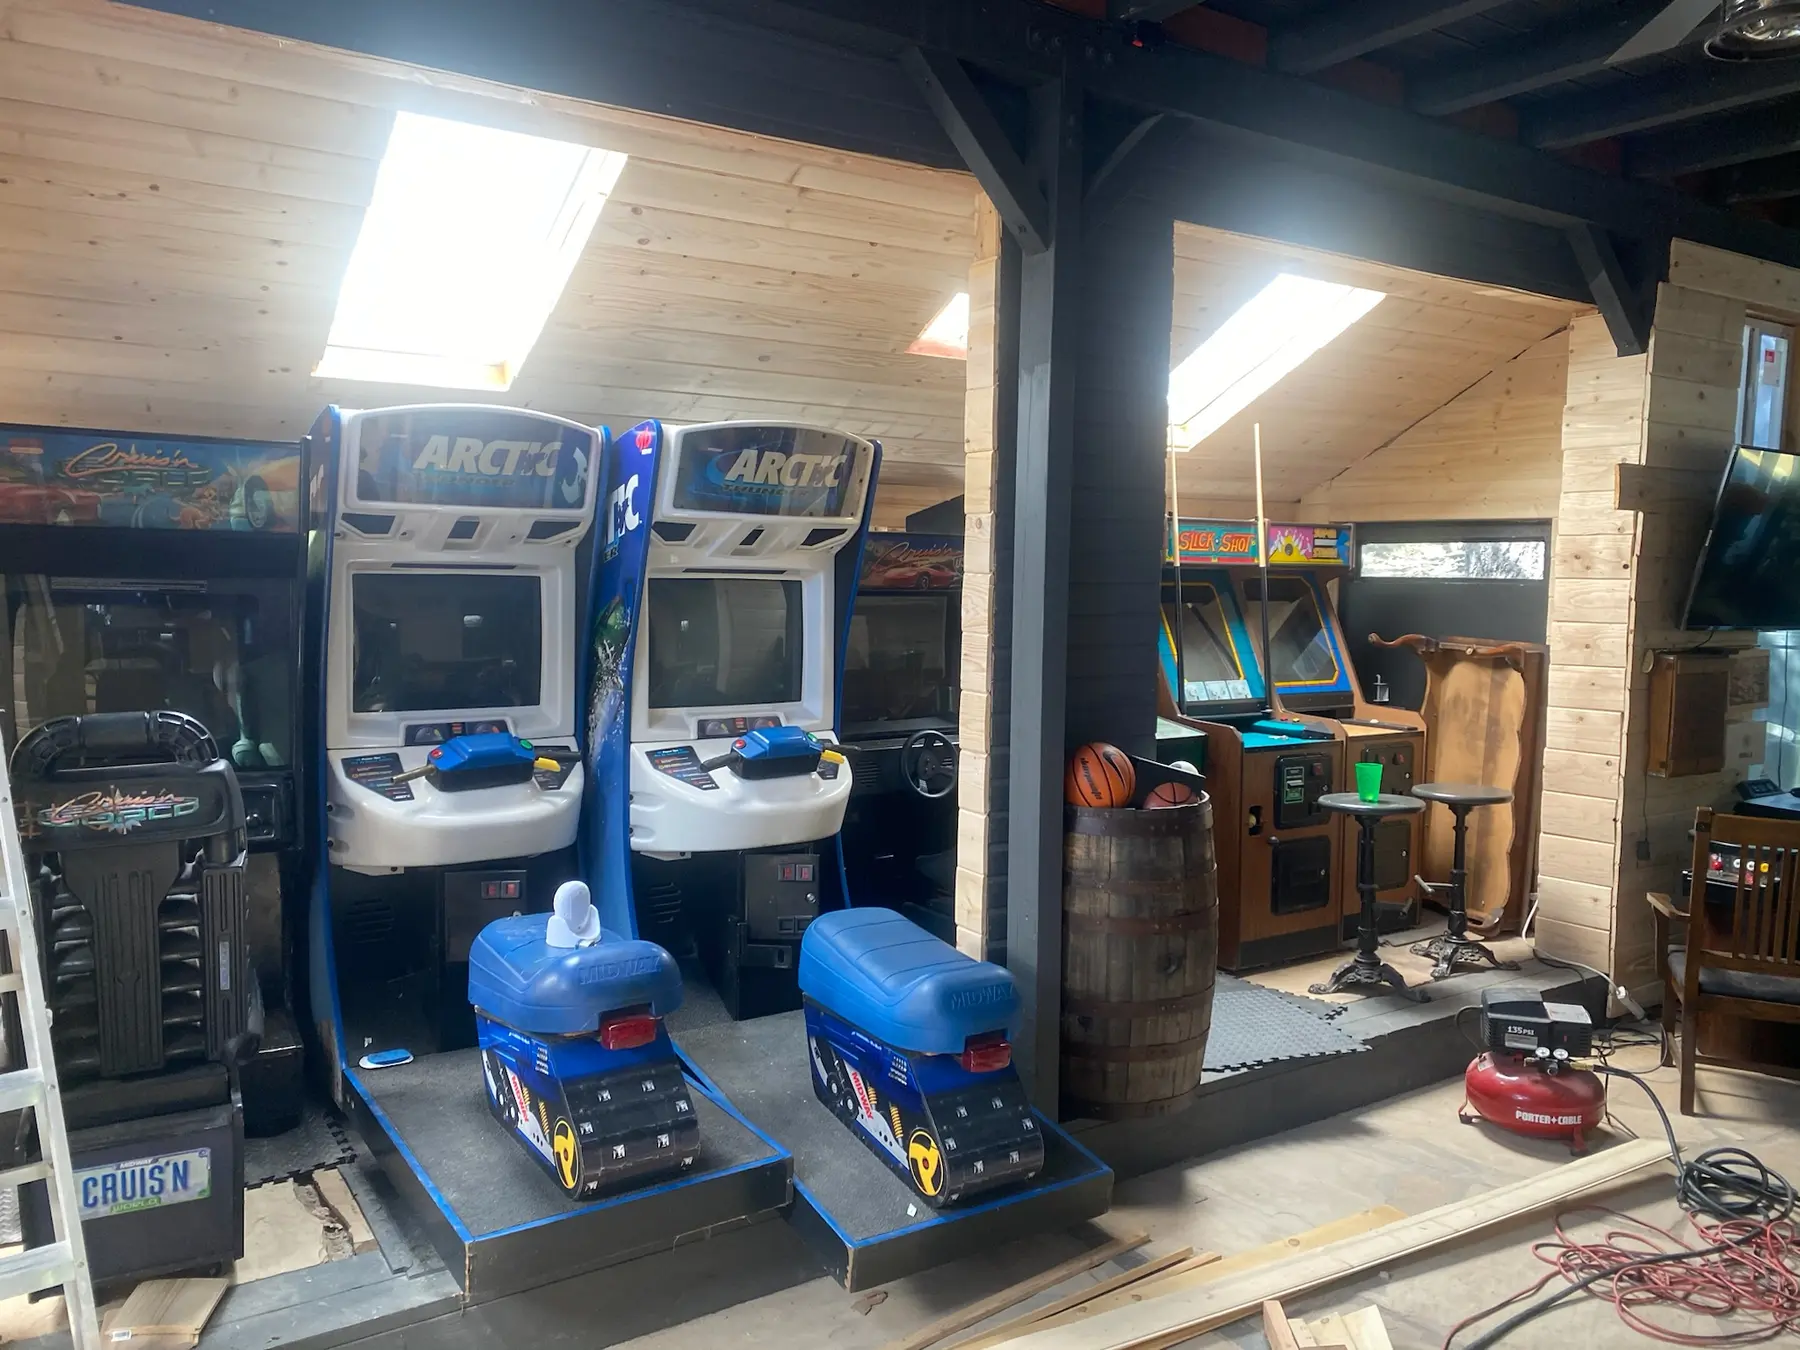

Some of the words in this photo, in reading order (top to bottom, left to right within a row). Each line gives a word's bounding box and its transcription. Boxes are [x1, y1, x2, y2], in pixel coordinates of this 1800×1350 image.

[412, 434, 562, 477] ARCTIC
[724, 448, 847, 488] ARCTIC
[1179, 531, 1216, 552] SLICK
[1220, 532, 1255, 553] SHOT
[580, 955, 660, 985] MIDWAY
[510, 1074, 529, 1122] MIDWAY
[851, 1071, 874, 1119] MIDWAY
[82, 1160, 189, 1208] CRUIS'N
